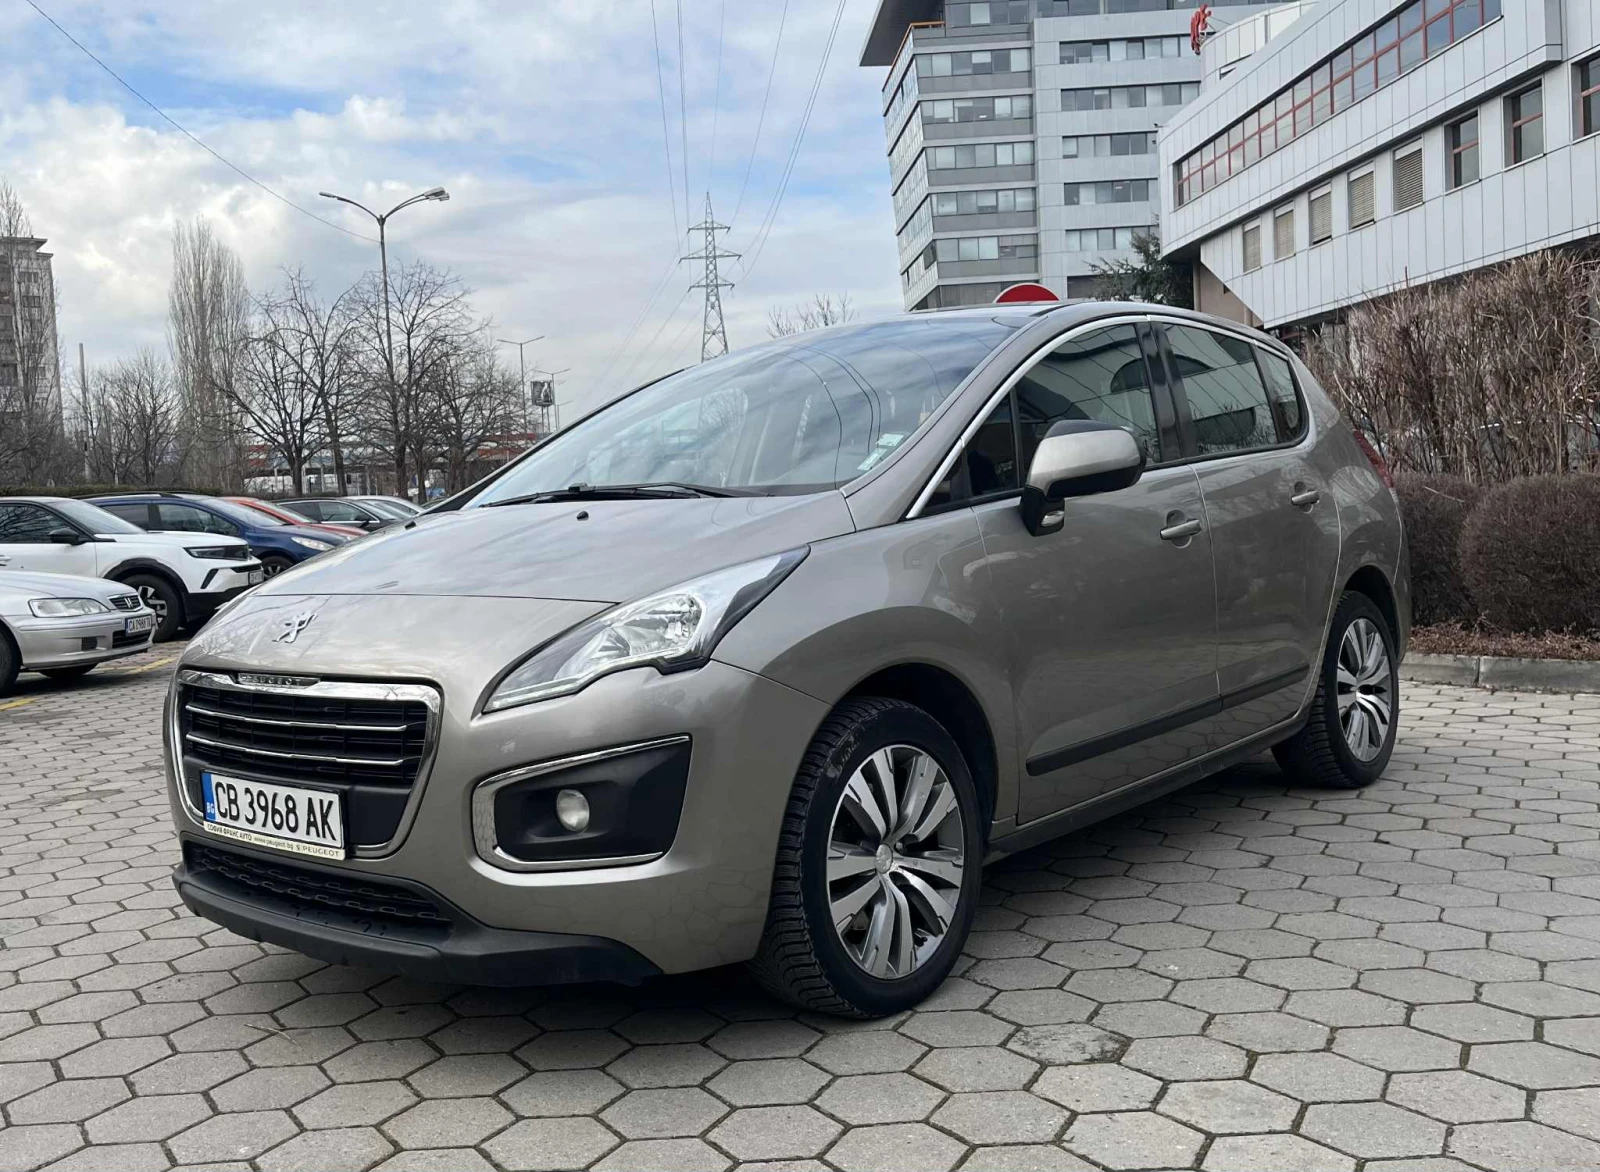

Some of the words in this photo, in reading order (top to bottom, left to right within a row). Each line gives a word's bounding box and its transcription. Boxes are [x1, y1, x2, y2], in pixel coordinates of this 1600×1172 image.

[215, 781, 240, 821] CB
[244, 787, 299, 833] 3968
[306, 797, 337, 841] AK
[302, 846, 340, 857] PEUGEOT
